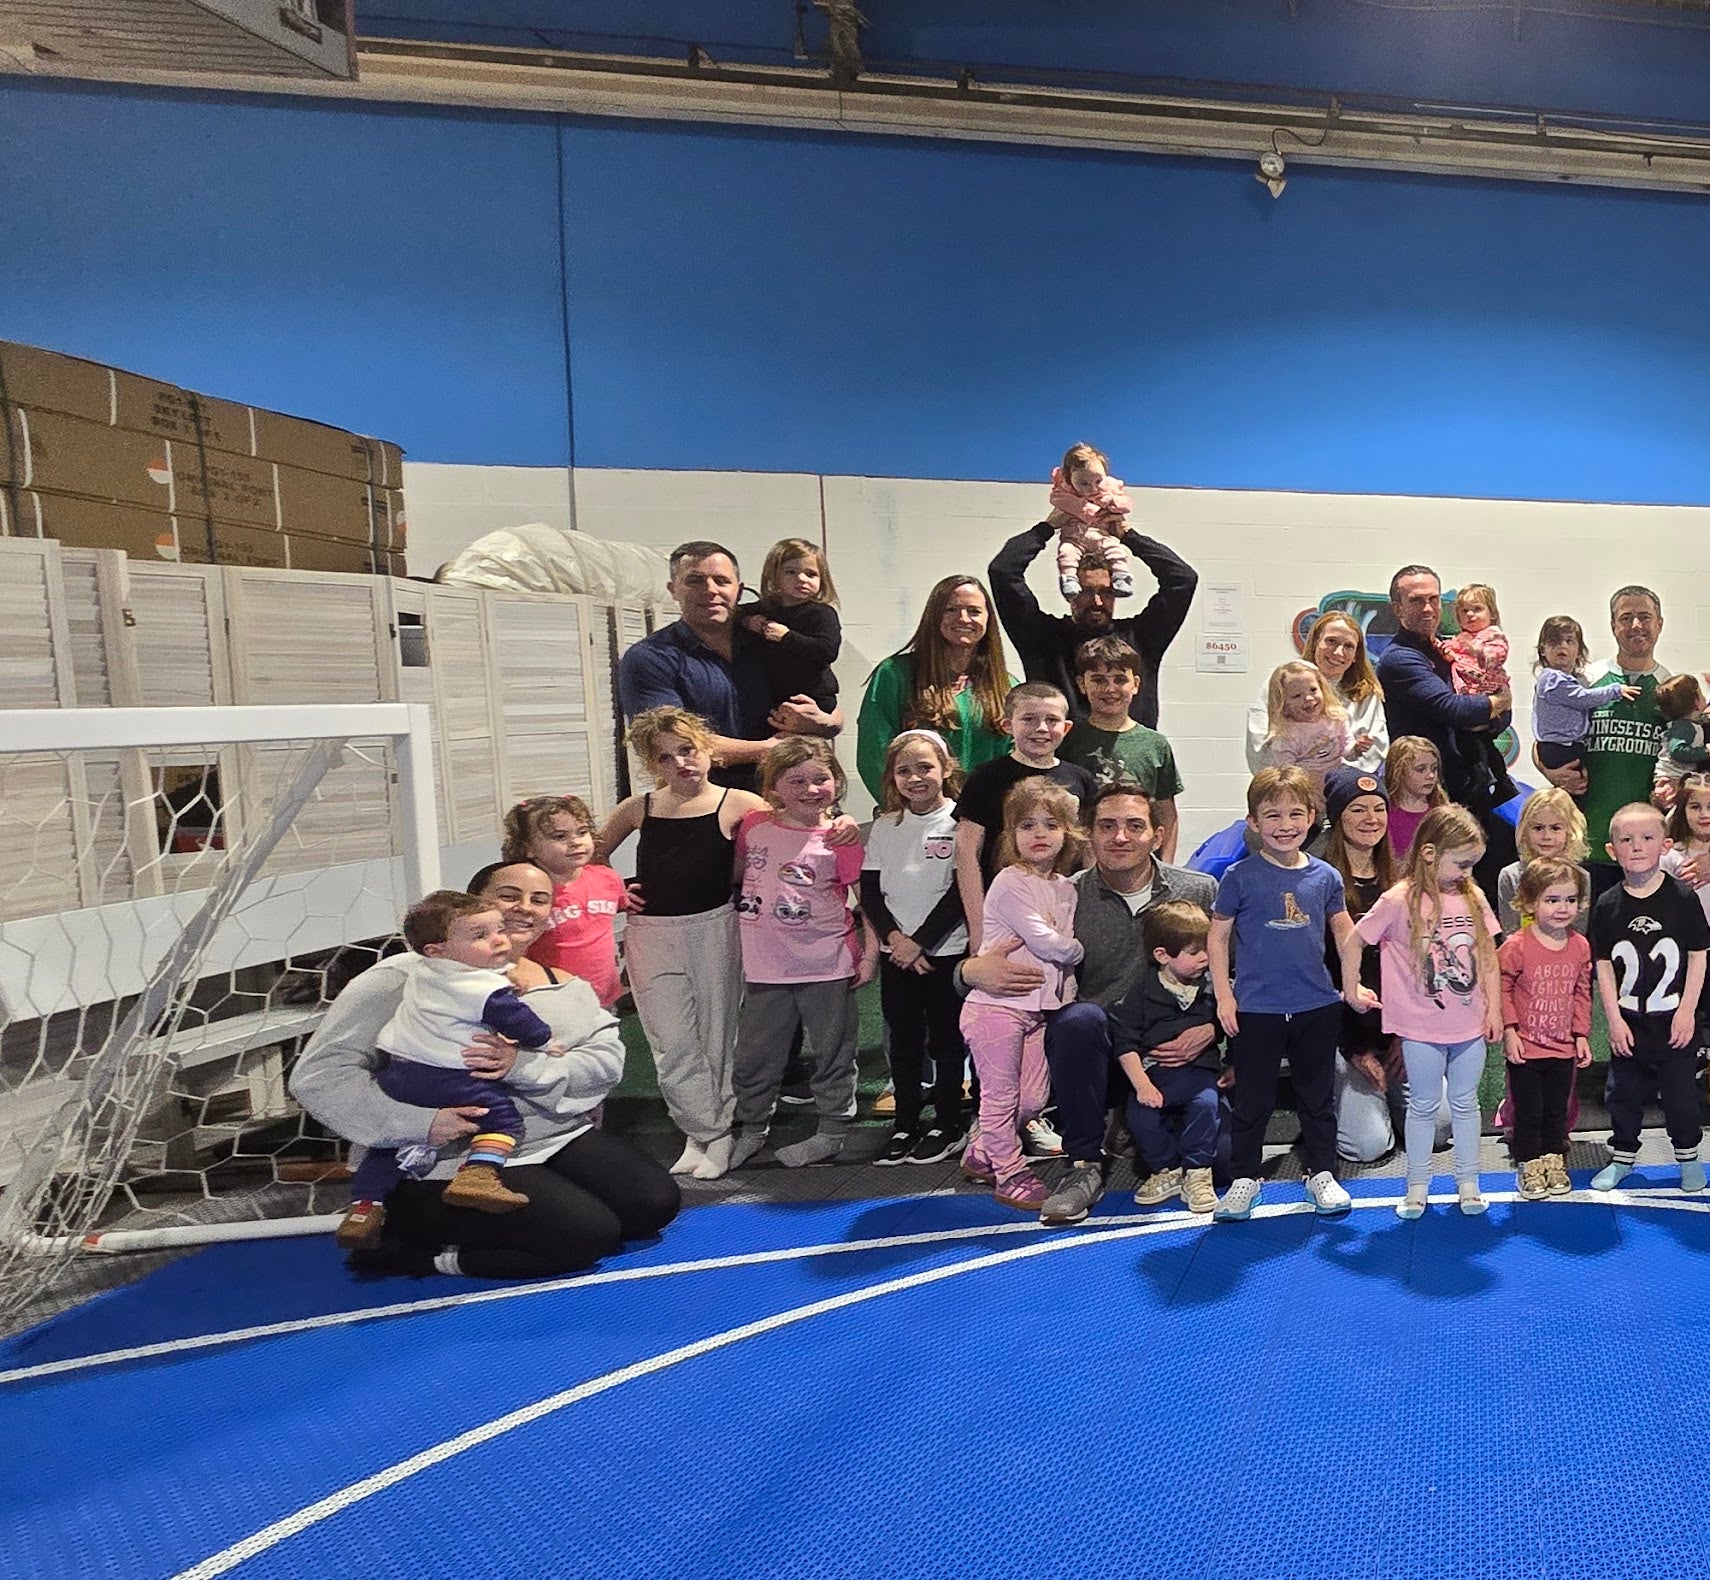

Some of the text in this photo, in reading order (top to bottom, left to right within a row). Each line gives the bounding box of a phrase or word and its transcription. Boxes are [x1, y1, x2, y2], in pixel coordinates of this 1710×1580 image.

[924, 841, 953, 859] 10
[587, 900, 617, 915] SIS
[1611, 937, 1680, 1013] 22
